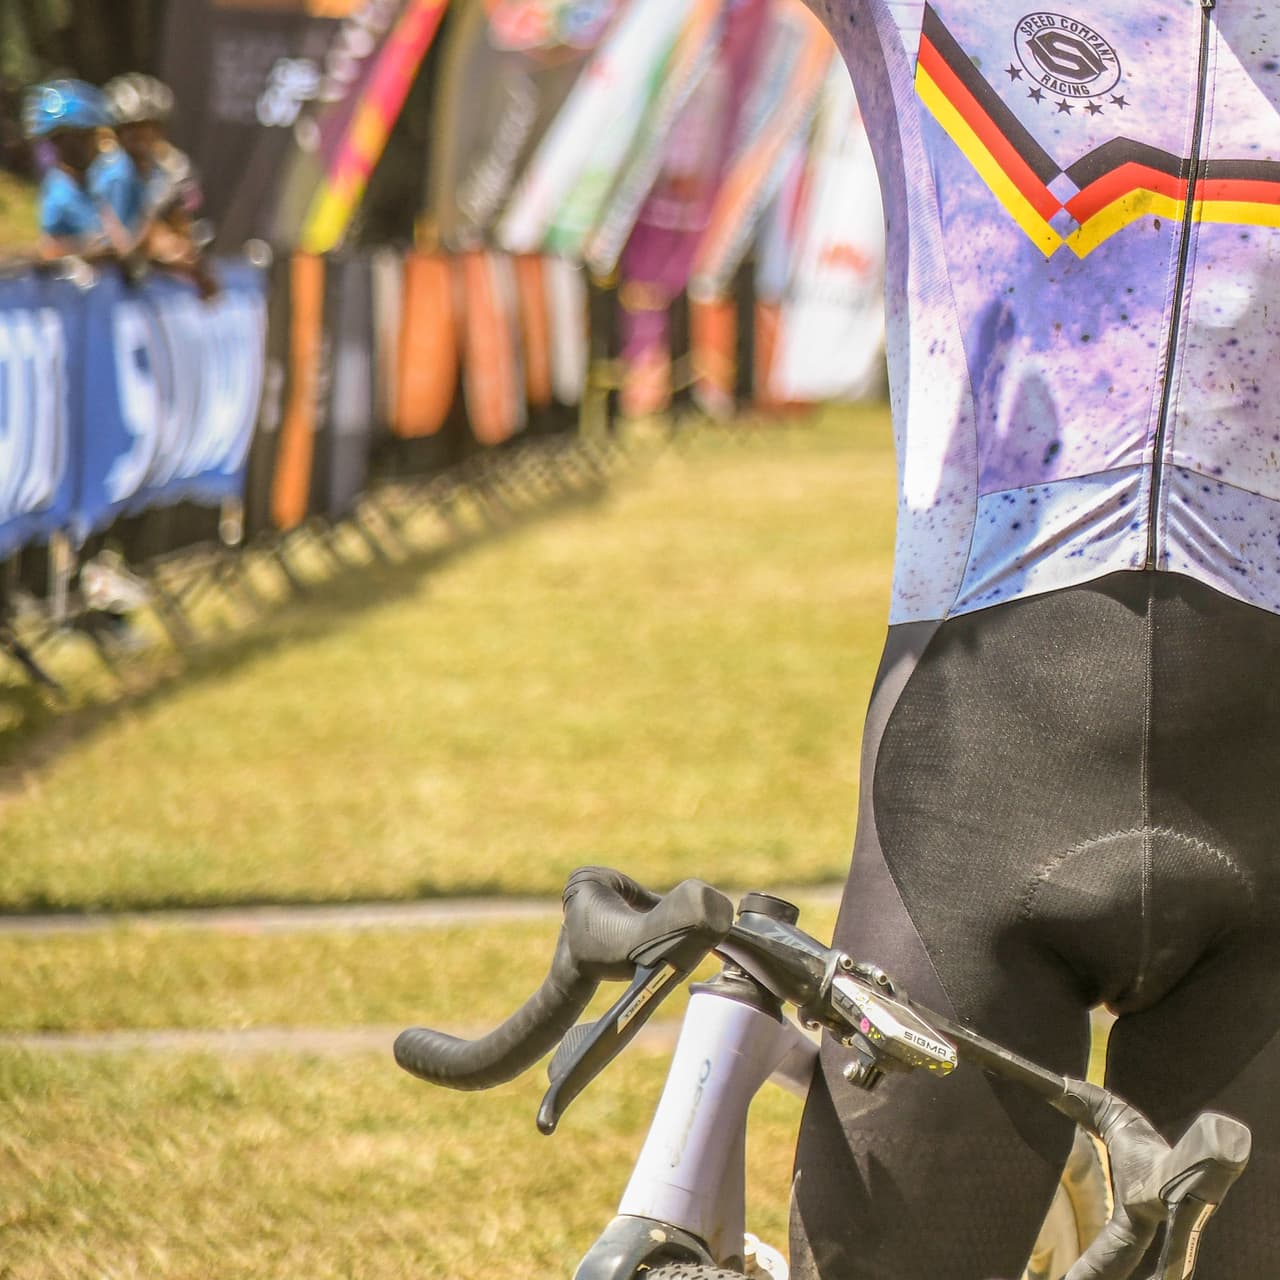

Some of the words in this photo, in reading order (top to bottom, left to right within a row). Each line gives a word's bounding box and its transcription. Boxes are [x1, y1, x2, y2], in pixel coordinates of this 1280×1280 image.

[1020, 15, 1056, 37] SPEED
[1060, 18, 1116, 63] COMPANY
[1041, 74, 1090, 96] RACING
[902, 1030, 947, 1058] SIGMA
